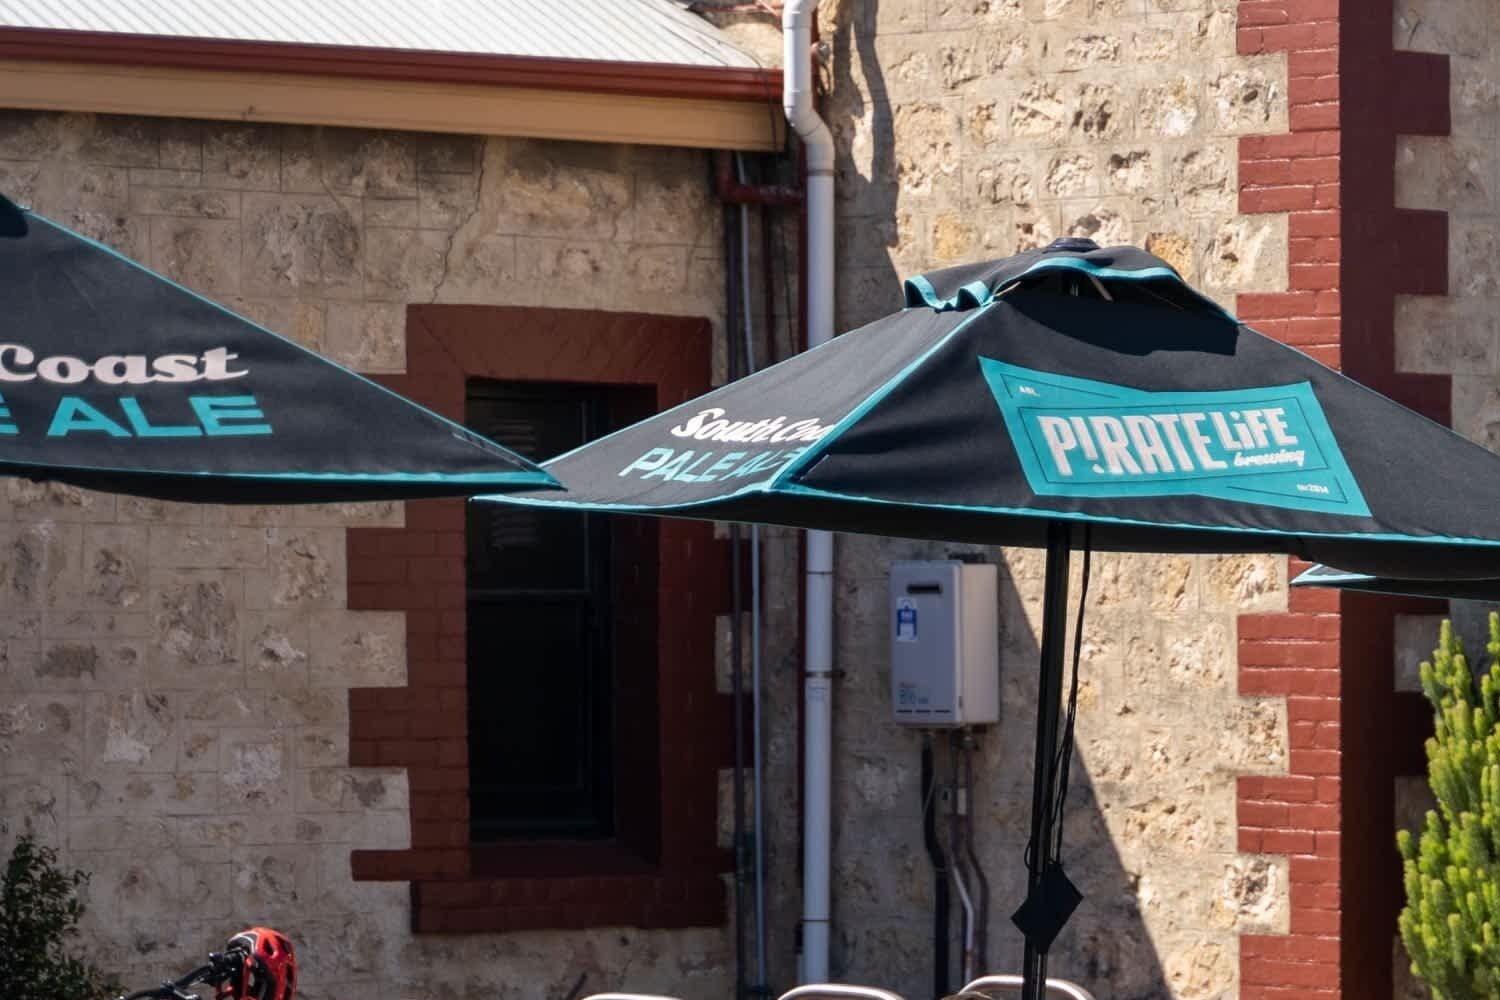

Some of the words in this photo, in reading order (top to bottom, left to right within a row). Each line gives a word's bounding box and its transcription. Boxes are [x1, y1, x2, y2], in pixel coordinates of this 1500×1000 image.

[0, 343, 249, 385] Coast
[47, 395, 273, 438] ALE
[671, 407, 788, 443] South
[618, 446, 747, 484] PALE
